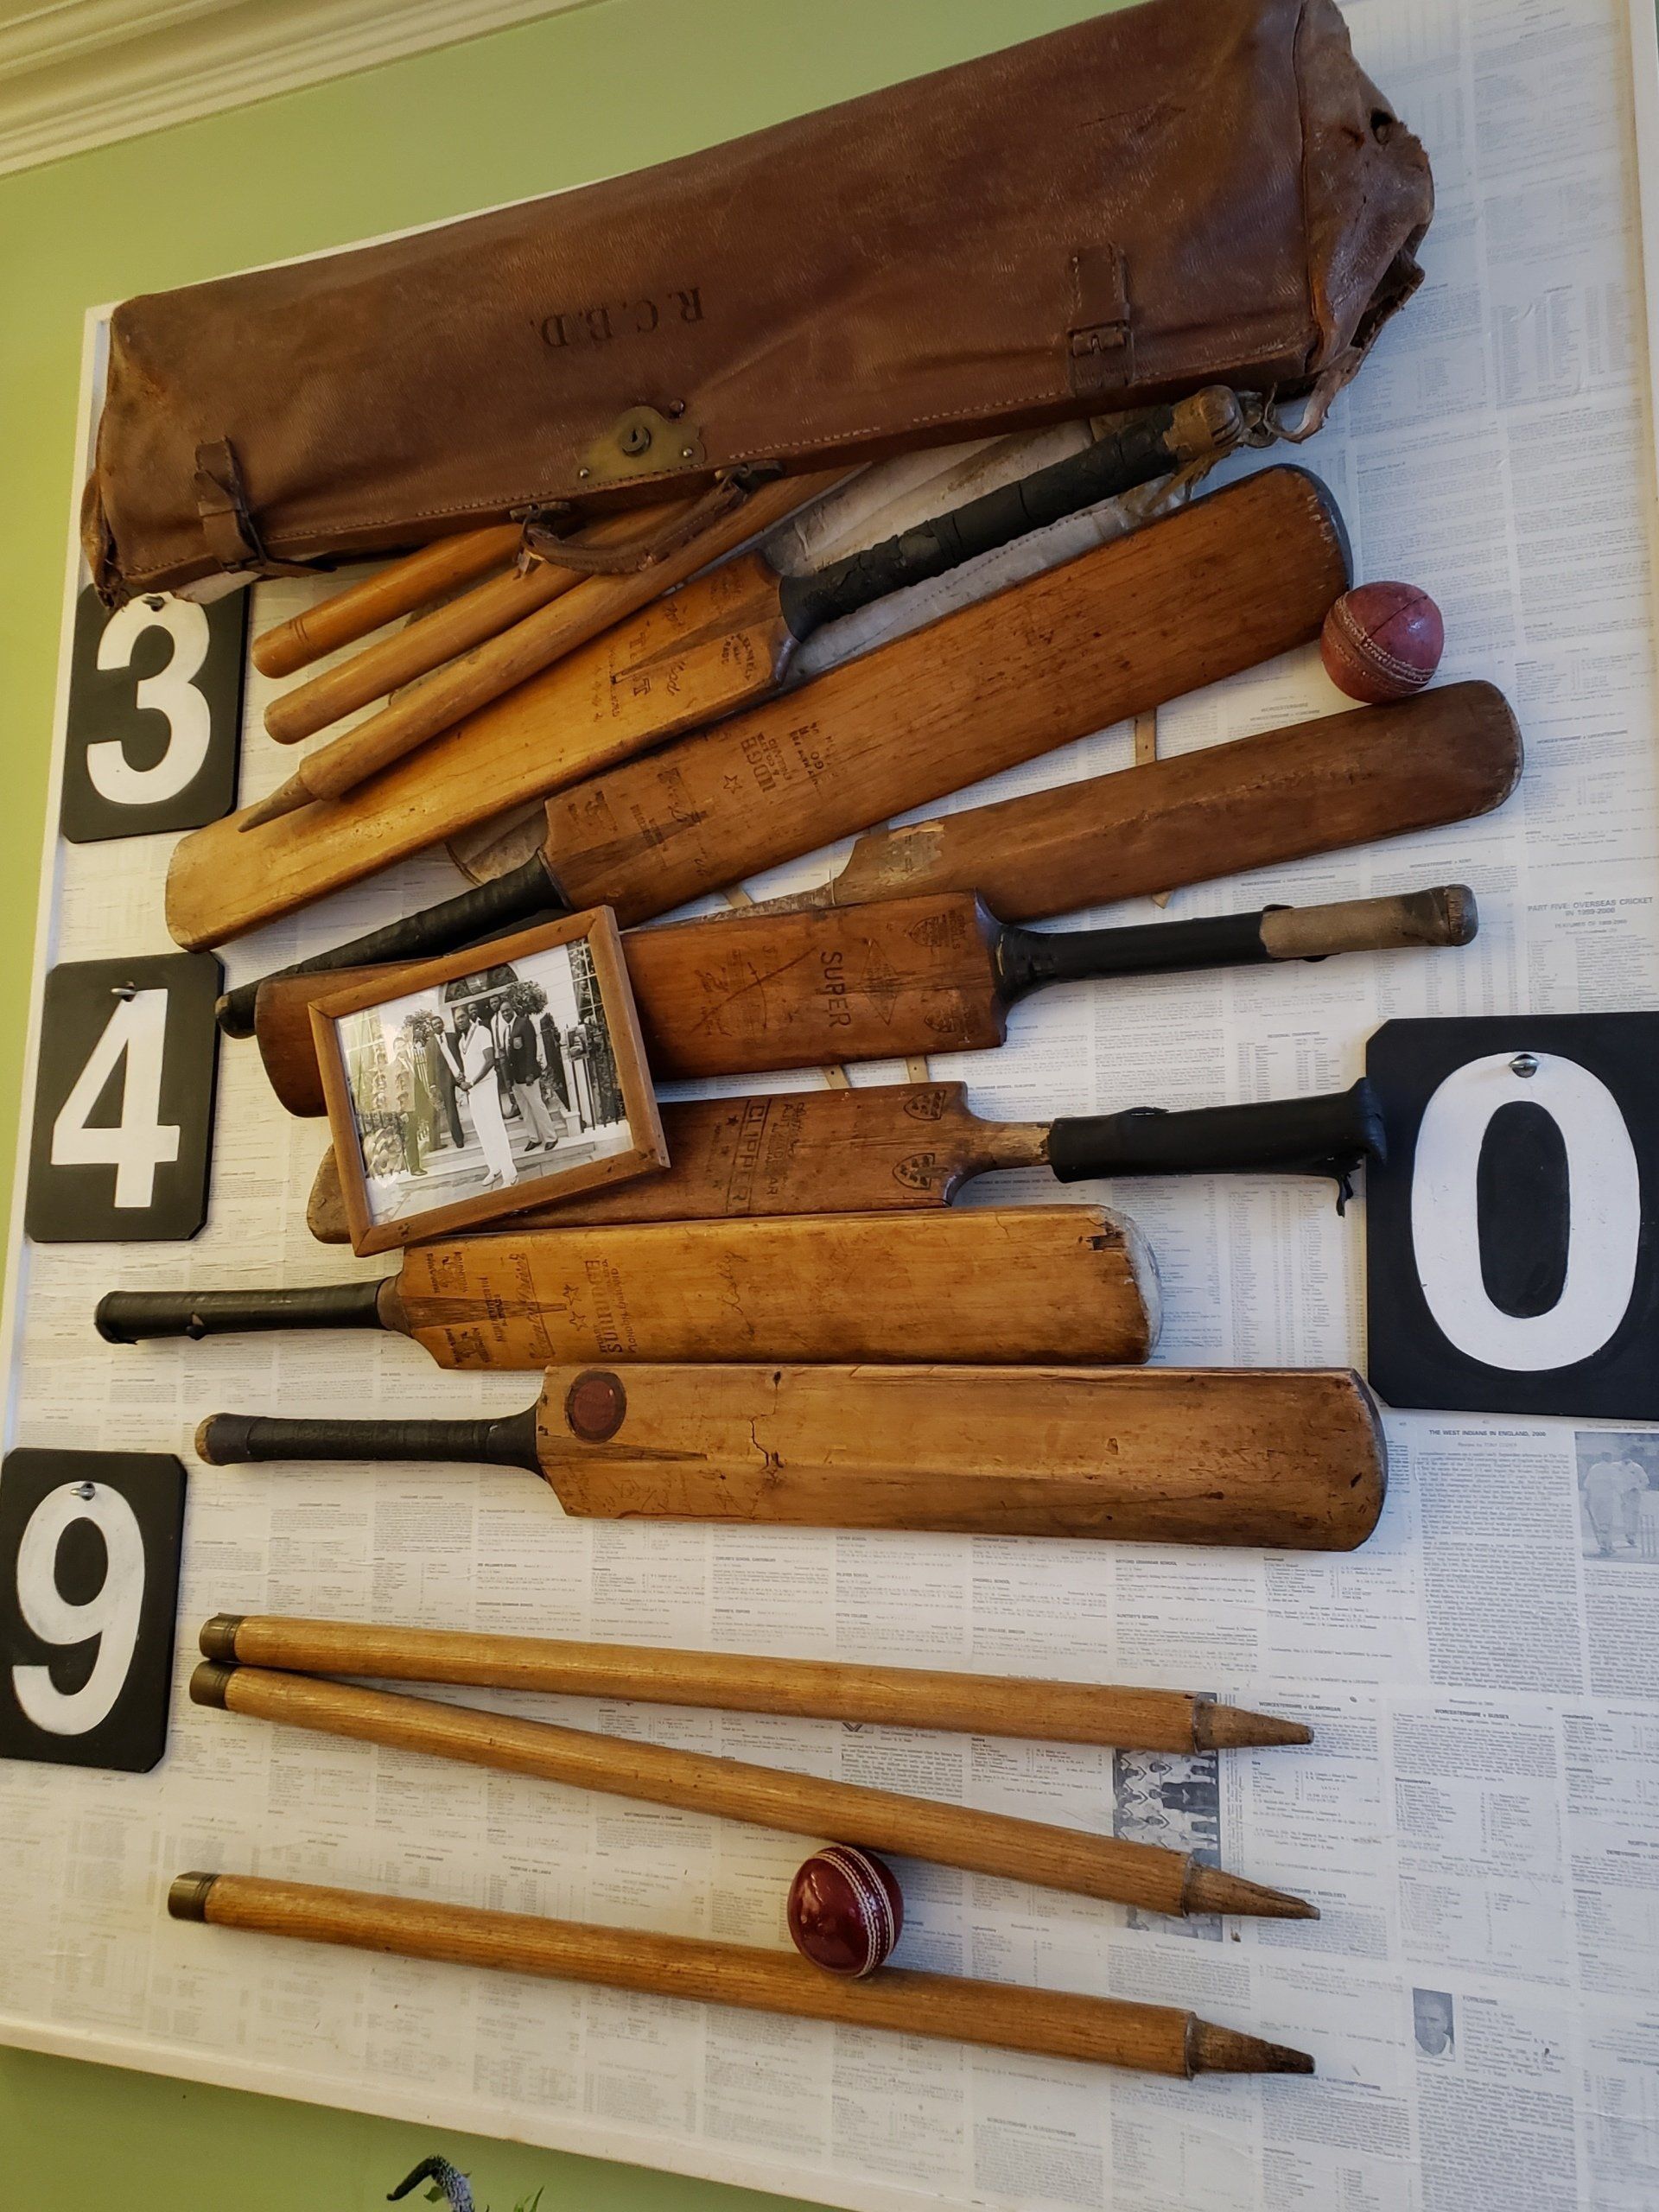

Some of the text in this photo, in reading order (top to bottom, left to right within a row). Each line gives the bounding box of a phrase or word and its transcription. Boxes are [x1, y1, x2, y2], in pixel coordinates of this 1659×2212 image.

[87, 591, 211, 804] 3
[1528, 904, 1548, 912] PART
[1573, 899, 1617, 909] OVERSEAS
[1618, 896, 1654, 906] CRICKET
[821, 950, 852, 1027] SUPER
[51, 988, 181, 1208] 4
[732, 1105, 765, 1201] CLIPPER
[13, 1481, 145, 1735] 9
[1258, 1700, 1302, 1710] WORCESTERSHIRE
[1434, 1708, 1481, 1718] WORCESTERSHIRE
